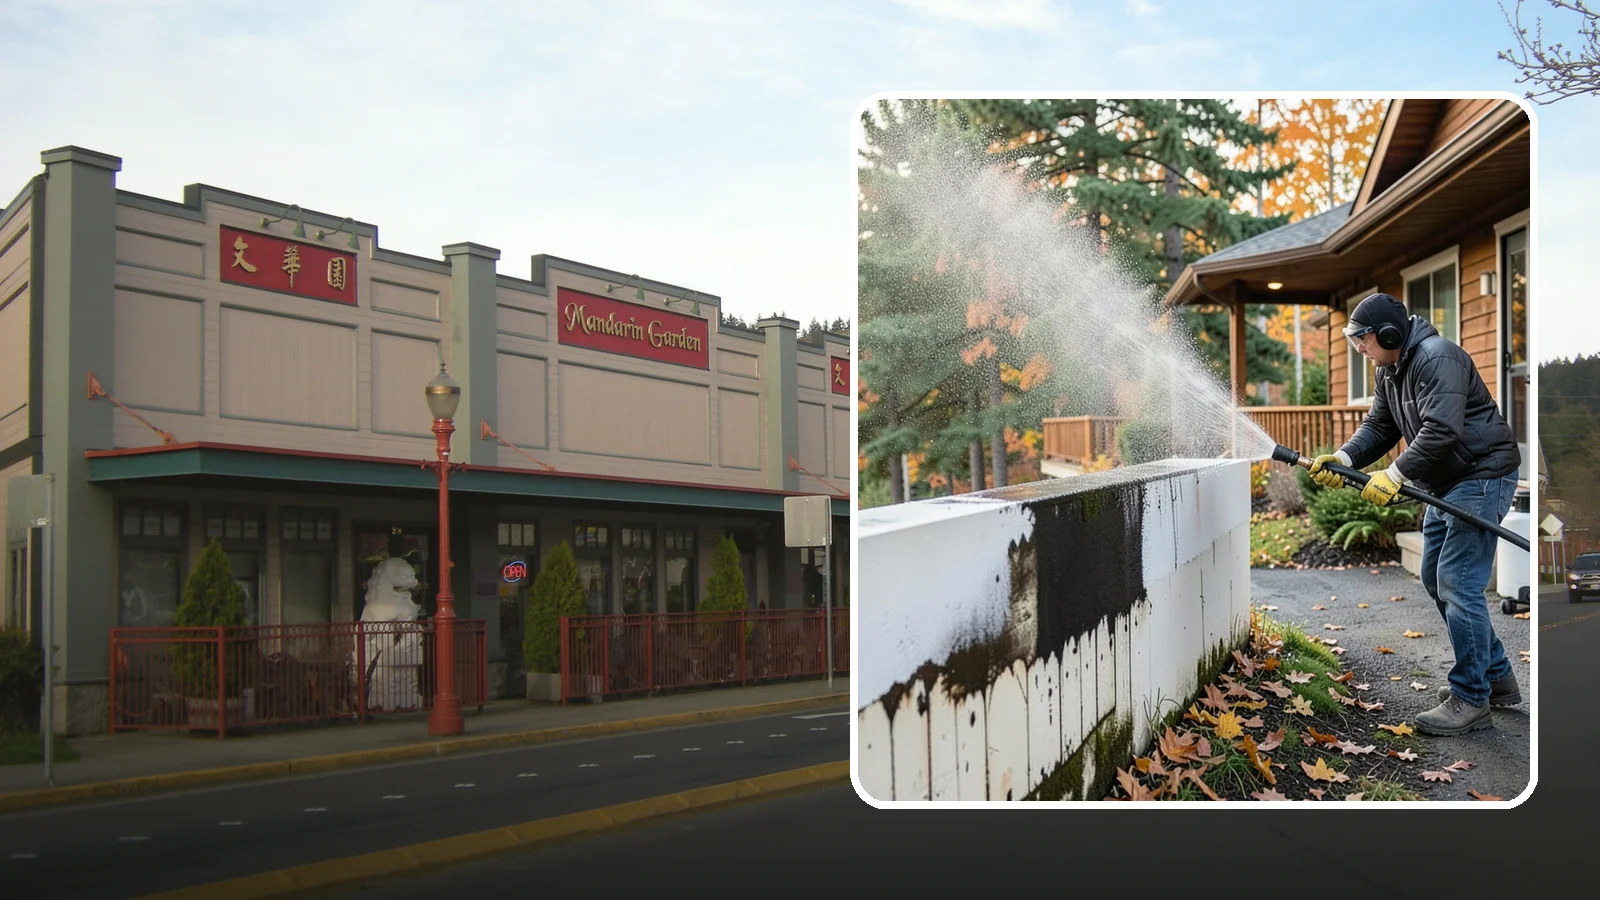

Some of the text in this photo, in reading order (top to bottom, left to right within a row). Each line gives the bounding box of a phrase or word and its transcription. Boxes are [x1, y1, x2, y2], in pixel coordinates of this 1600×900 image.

[231, 235, 346, 291] 文華園
[564, 302, 701, 352] Mandarin Garden
[503, 565, 527, 578] OPEN
